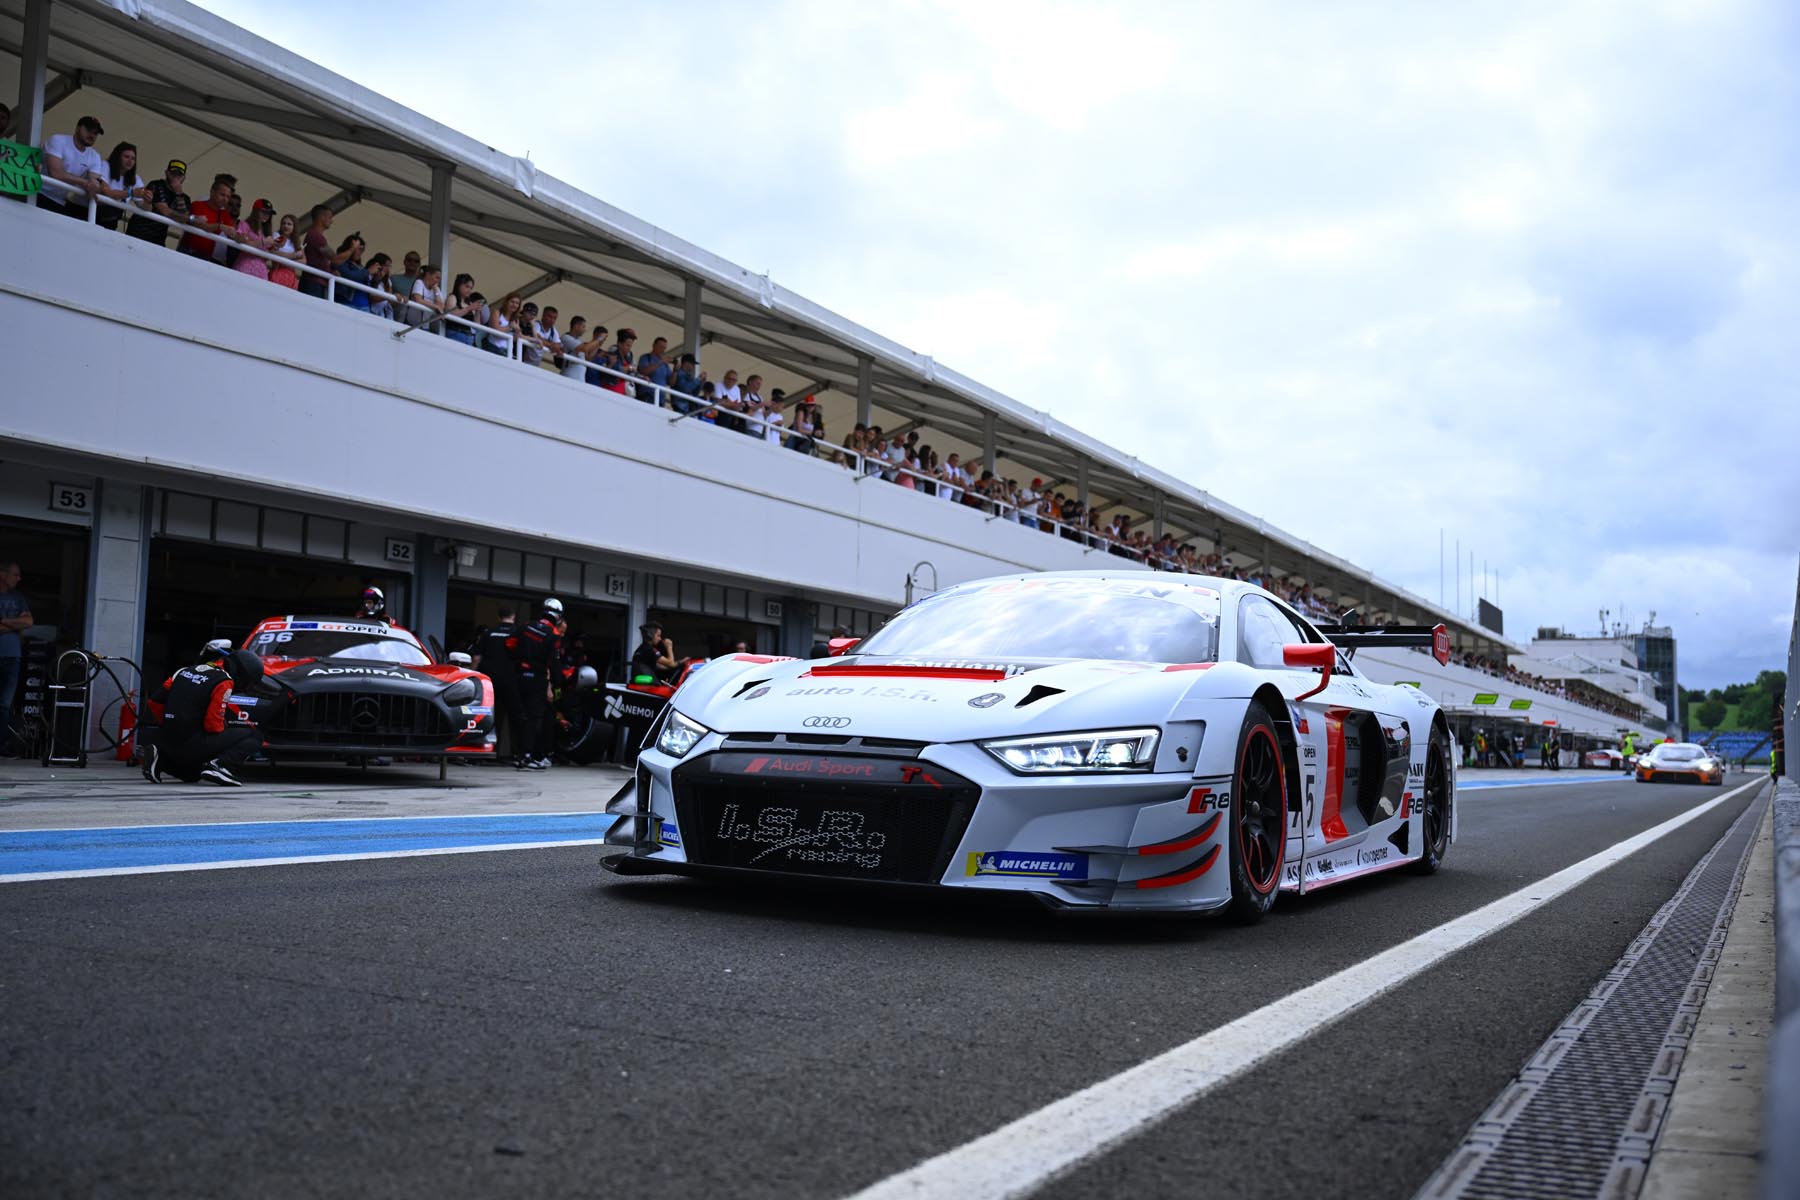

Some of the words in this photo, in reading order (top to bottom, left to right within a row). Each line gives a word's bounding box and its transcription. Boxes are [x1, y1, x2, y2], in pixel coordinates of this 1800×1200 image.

[60, 490, 86, 509] 53
[392, 544, 410, 559] 52
[612, 580, 624, 593] 51
[258, 631, 294, 644] 96
[307, 668, 420, 681] ADMIRAL
[785, 686, 854, 697] auto
[619, 705, 655, 718] ANEMOI
[768, 757, 811, 773] Audi
[818, 759, 876, 777] Sport
[1200, 792, 1230, 810] R8
[1408, 797, 1424, 815] R8
[999, 859, 1076, 871] MICHELIN
